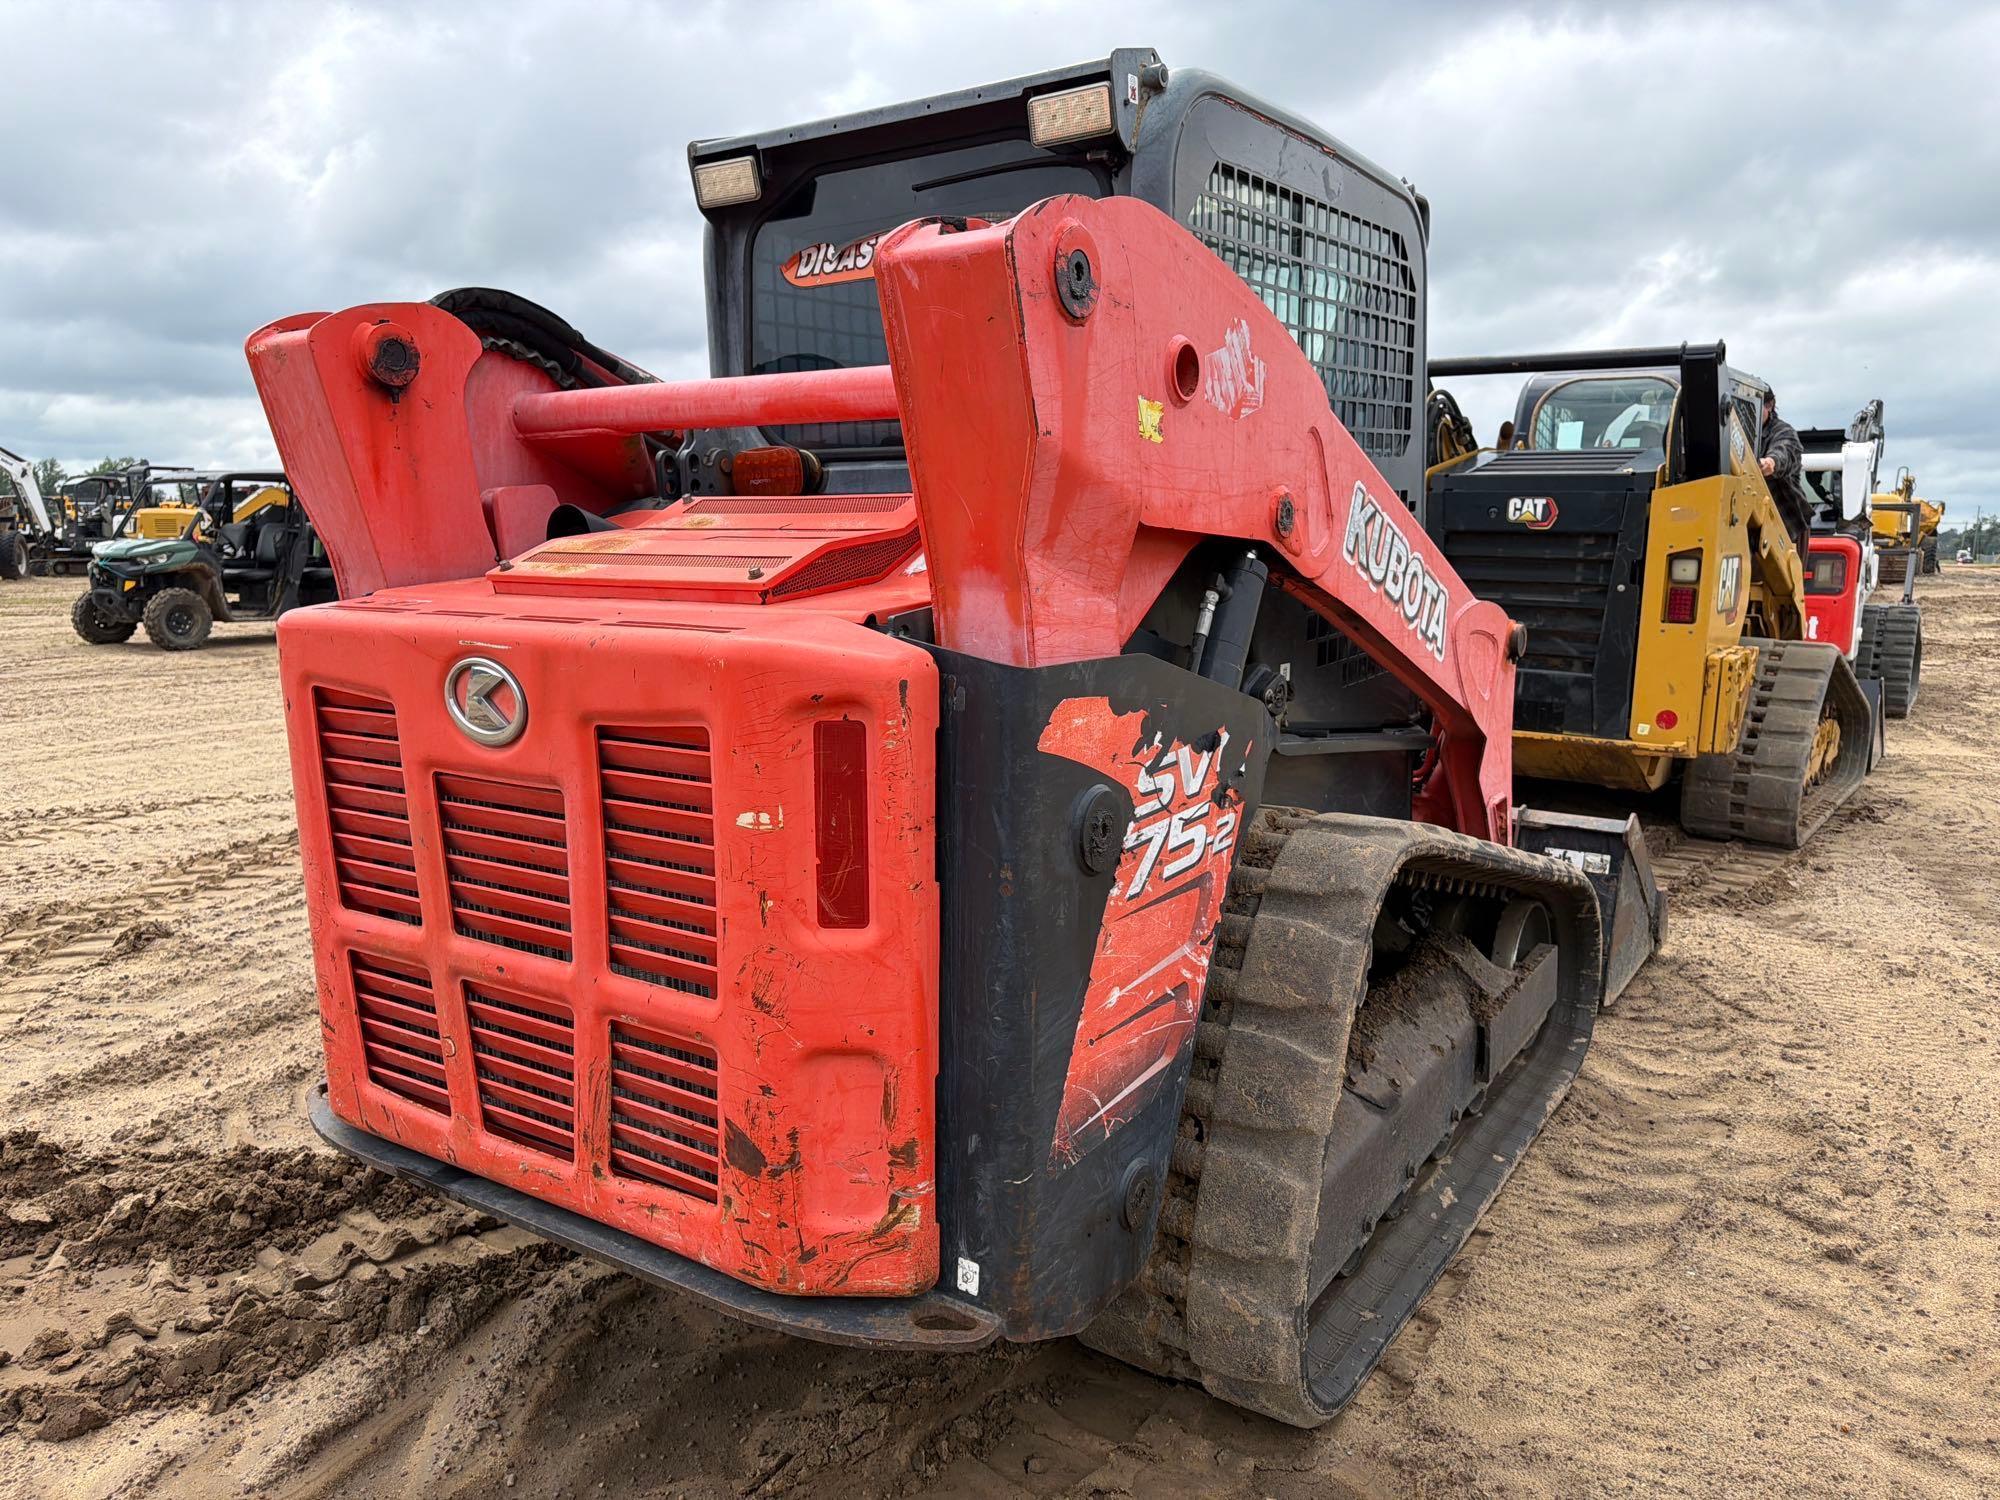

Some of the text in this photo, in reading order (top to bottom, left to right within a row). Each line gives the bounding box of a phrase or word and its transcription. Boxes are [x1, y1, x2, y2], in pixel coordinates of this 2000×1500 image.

[795, 236, 878, 277] DISAS
[1508, 497, 1547, 522] CAT
[1345, 485, 1447, 656] KUBOTA
[1717, 556, 1740, 611] CAT
[1134, 745, 1213, 822] SV
